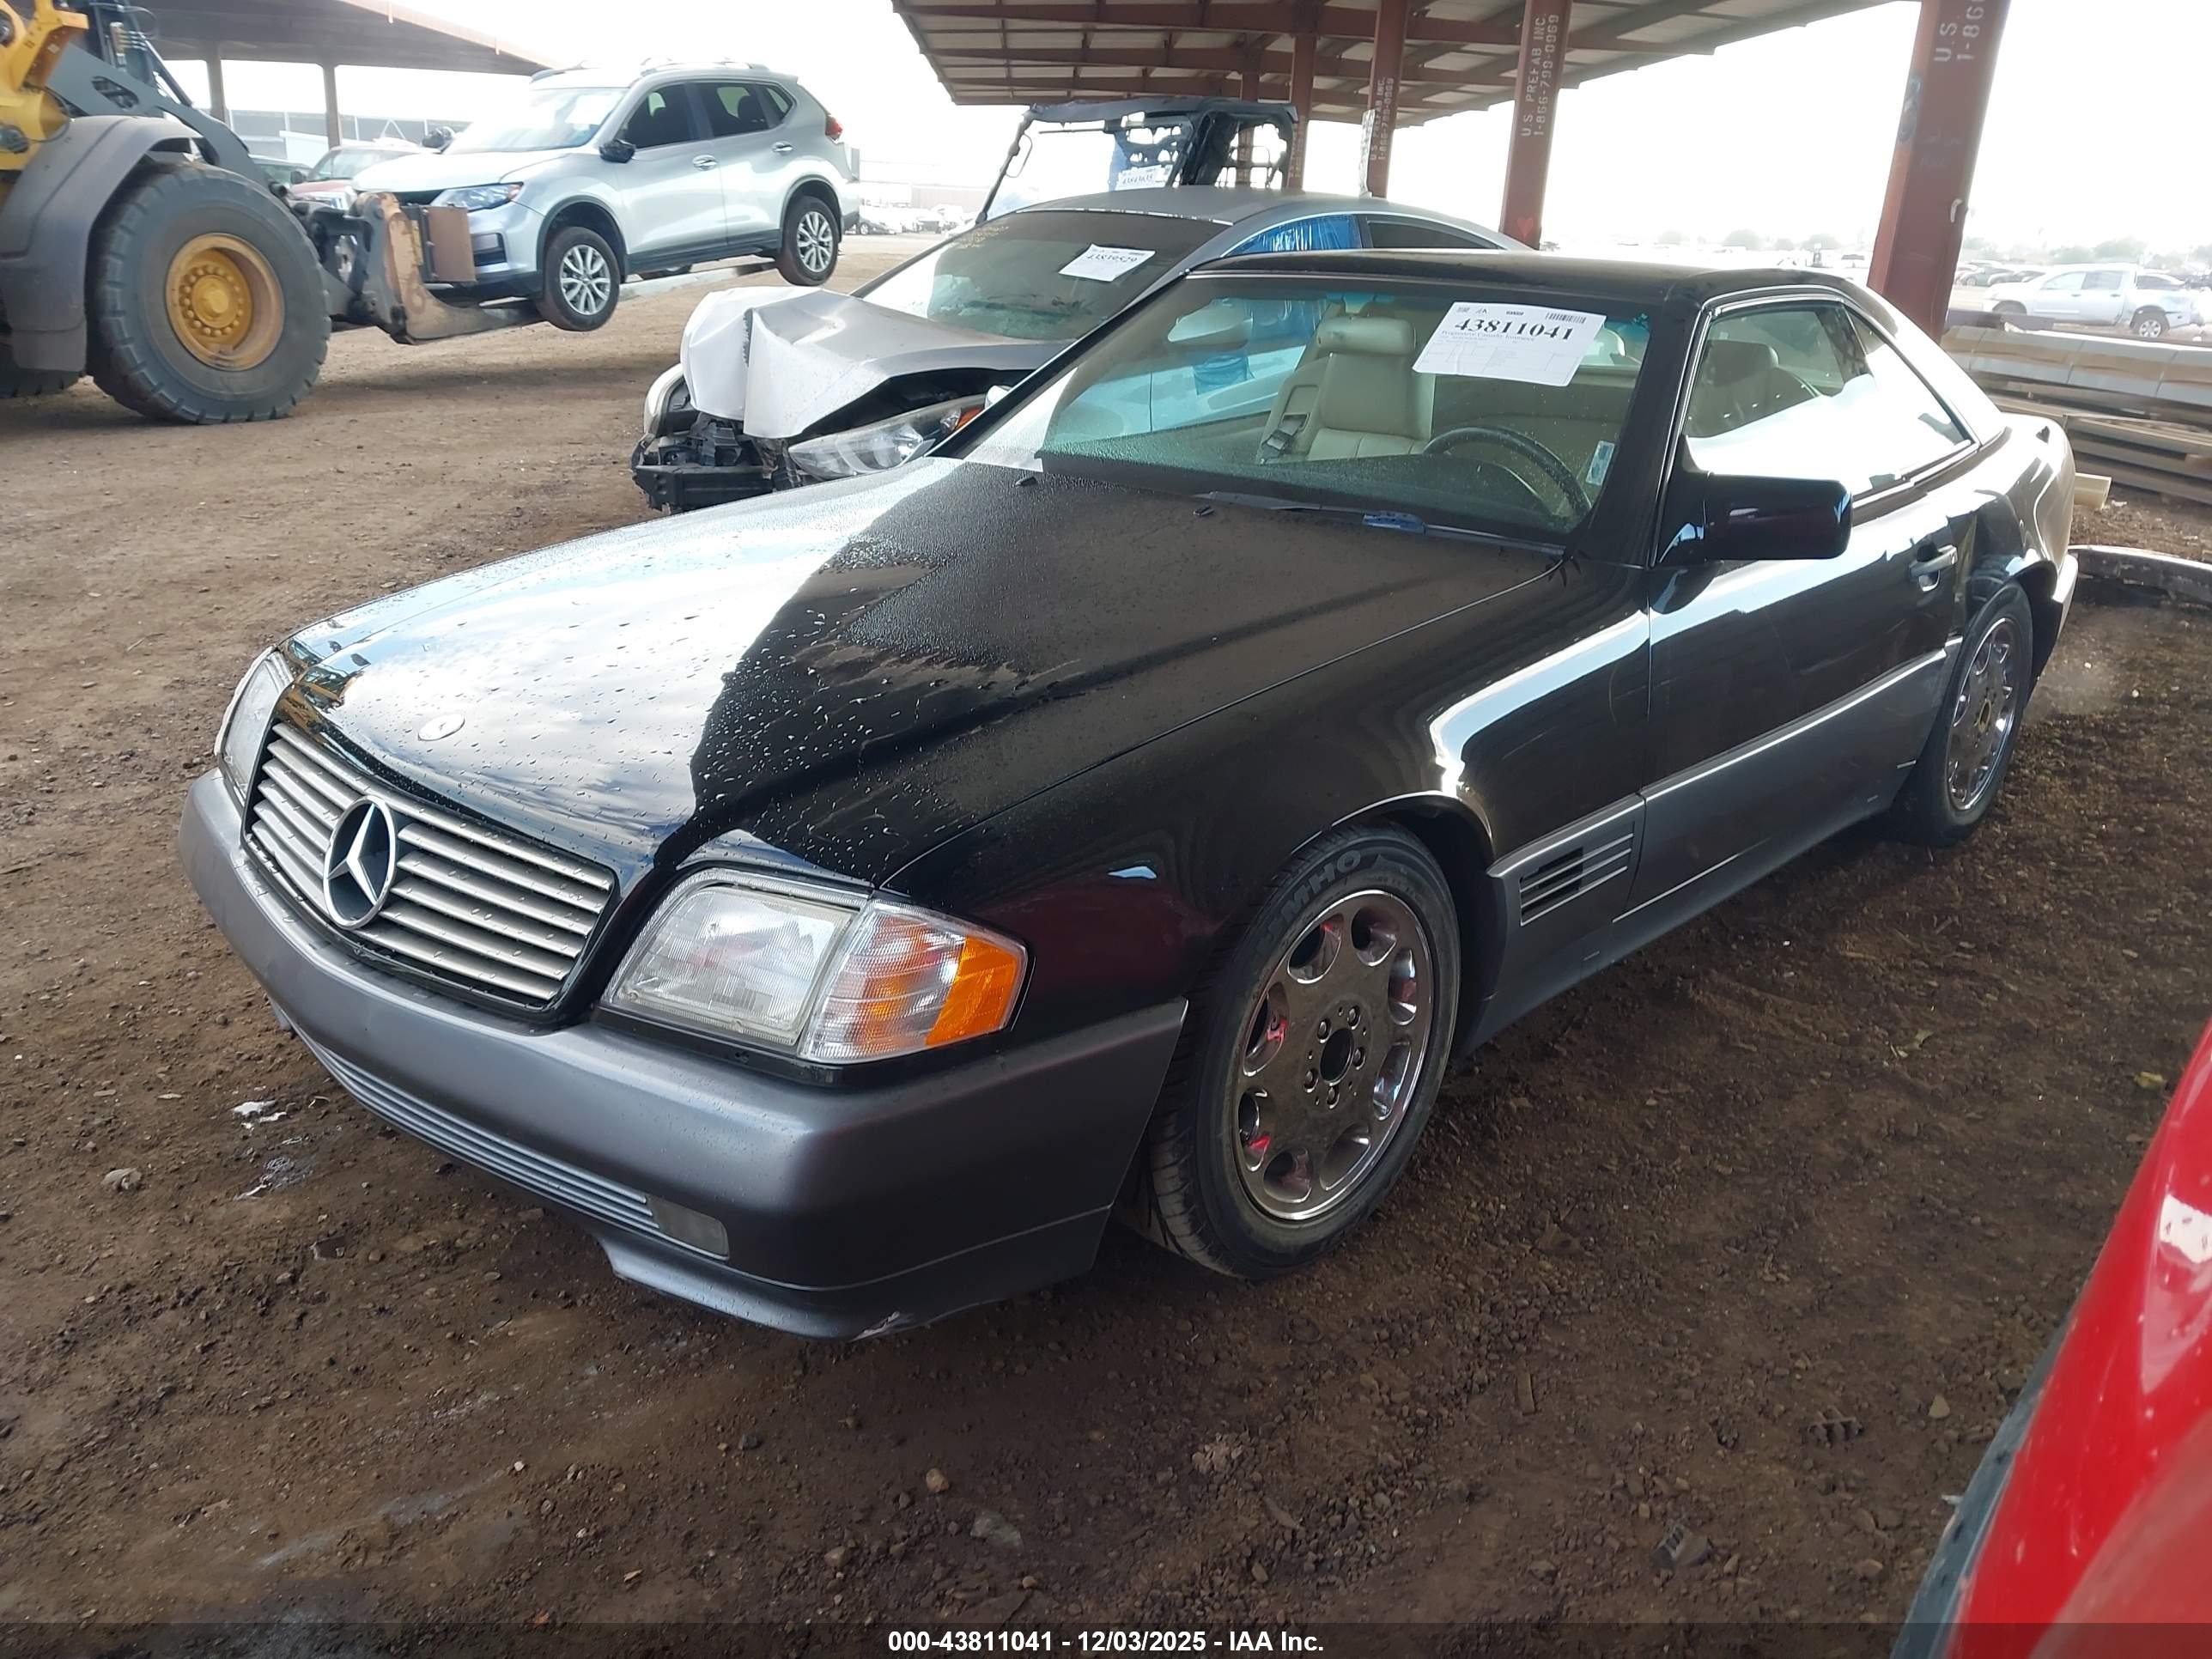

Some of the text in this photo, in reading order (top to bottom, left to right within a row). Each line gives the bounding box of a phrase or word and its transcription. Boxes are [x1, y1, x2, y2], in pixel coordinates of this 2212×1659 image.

[1526, 48, 1542, 102] PREFAB
[1534, 15, 1559, 136] 1-866-799-0969
[1455, 318, 1574, 341] 43811041
